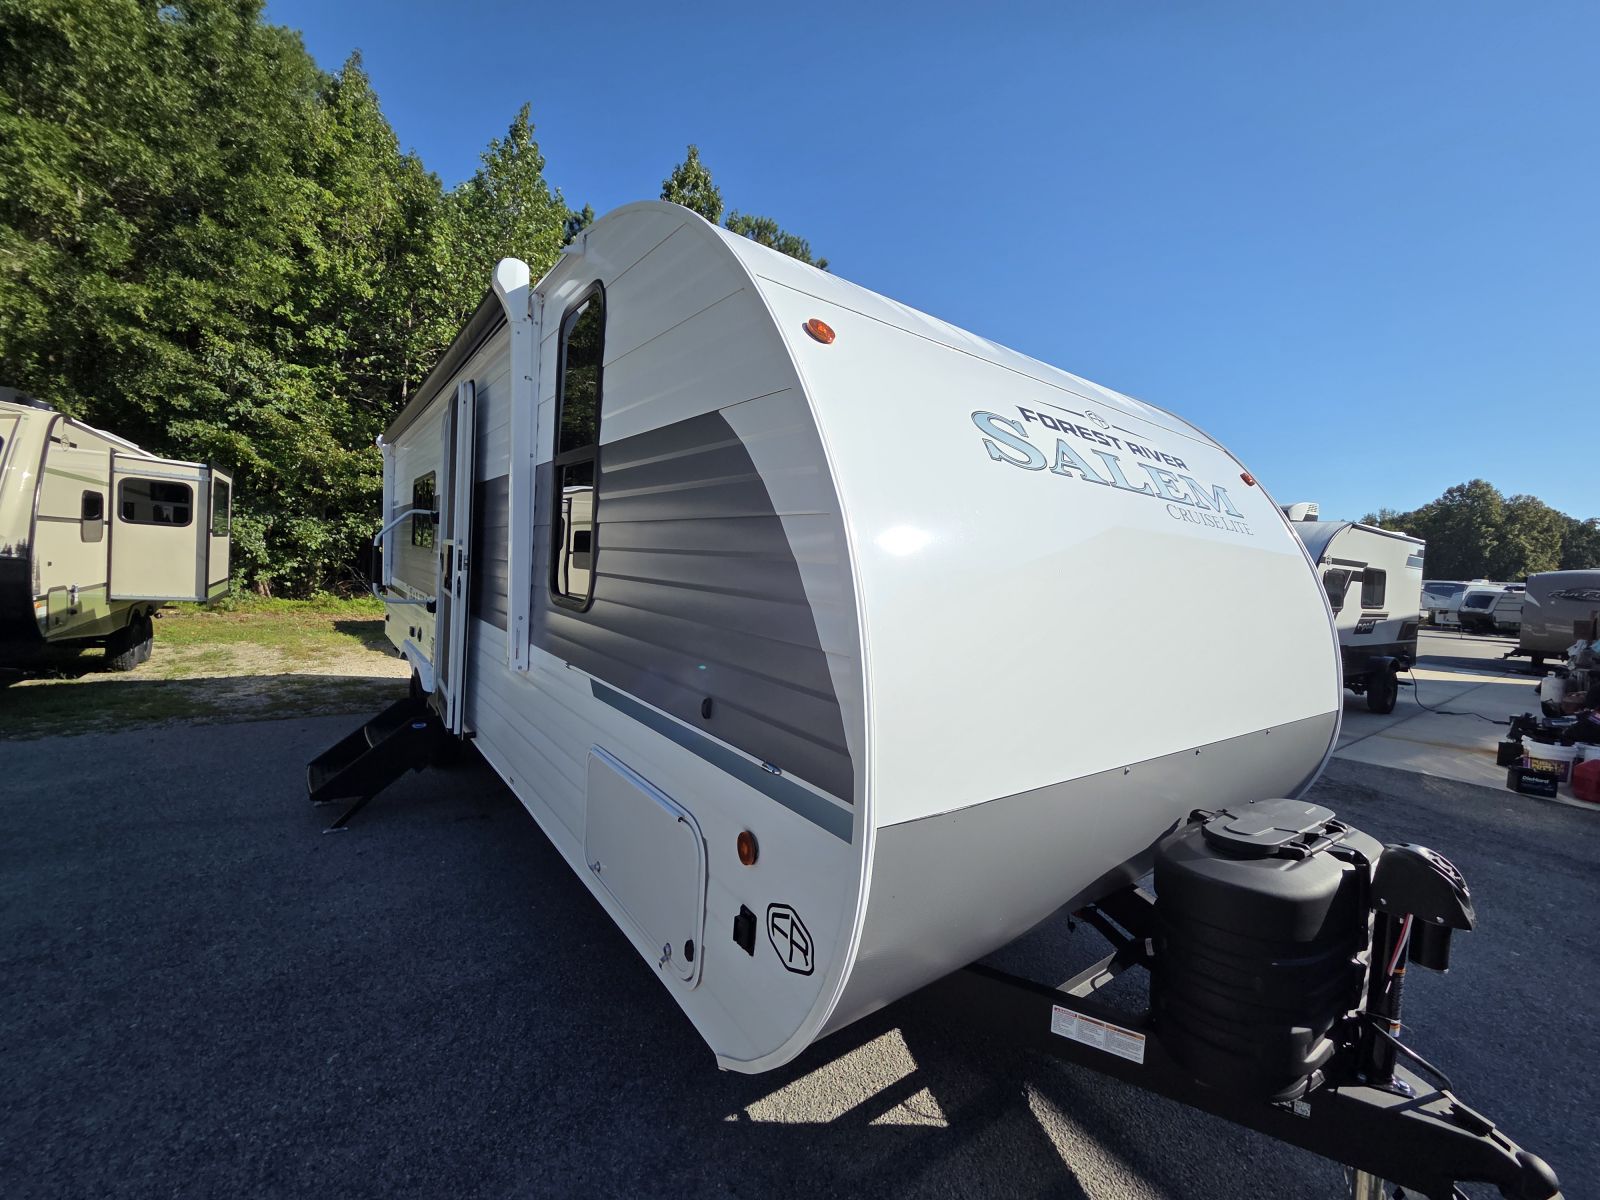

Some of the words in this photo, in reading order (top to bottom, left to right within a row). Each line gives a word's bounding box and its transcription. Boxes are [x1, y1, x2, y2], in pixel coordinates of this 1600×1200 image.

[971, 410, 1244, 518] SALEM
[1016, 405, 1122, 450] FOREST
[1123, 440, 1190, 471] RIVER
